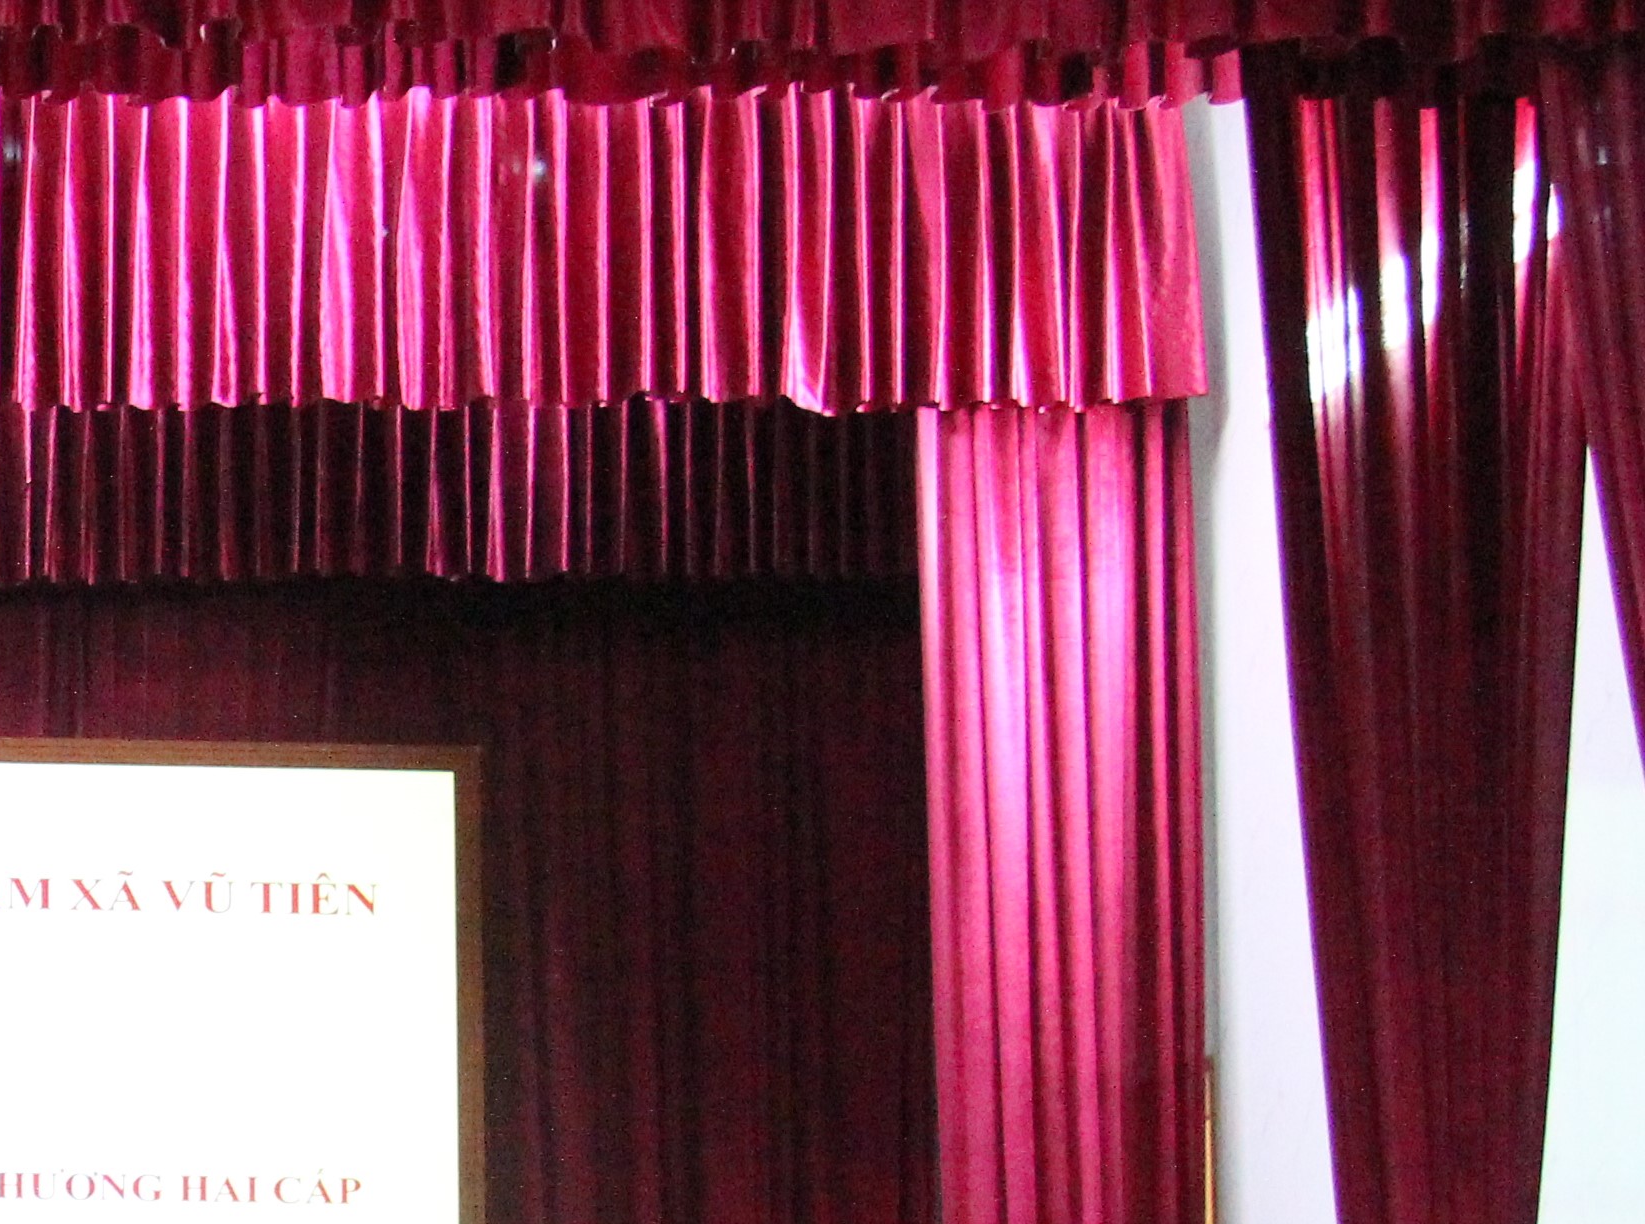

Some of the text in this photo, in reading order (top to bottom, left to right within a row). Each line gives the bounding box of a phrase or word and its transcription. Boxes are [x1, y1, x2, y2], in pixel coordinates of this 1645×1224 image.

[71, 870, 142, 912] XÃ
[162, 871, 233, 913] VŨ
[250, 871, 377, 916] TIÊN
[182, 1175, 257, 1203] HAI
